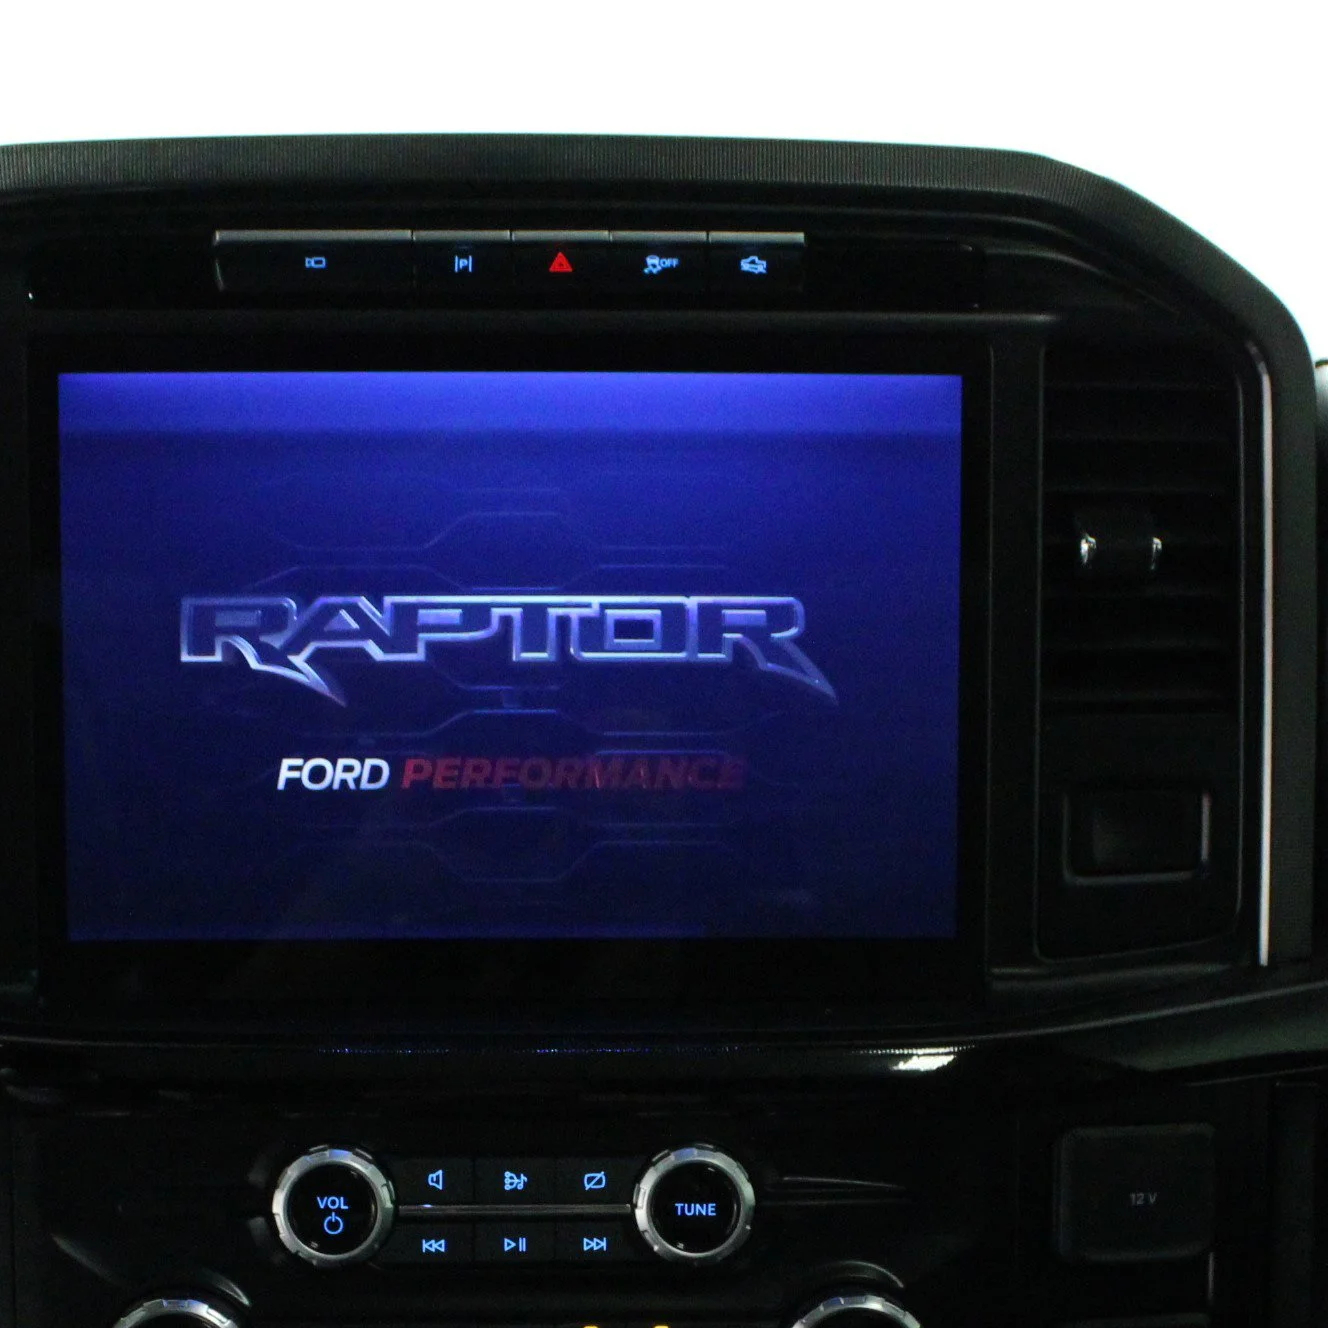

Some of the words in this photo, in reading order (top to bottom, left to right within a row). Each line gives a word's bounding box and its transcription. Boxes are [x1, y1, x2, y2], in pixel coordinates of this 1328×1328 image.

[179, 594, 838, 708] RAPTOR
[276, 756, 391, 791] FORD
[400, 756, 750, 791] PERFORMANCE
[316, 1195, 350, 1211] VOL
[674, 1202, 718, 1217] TUNE
